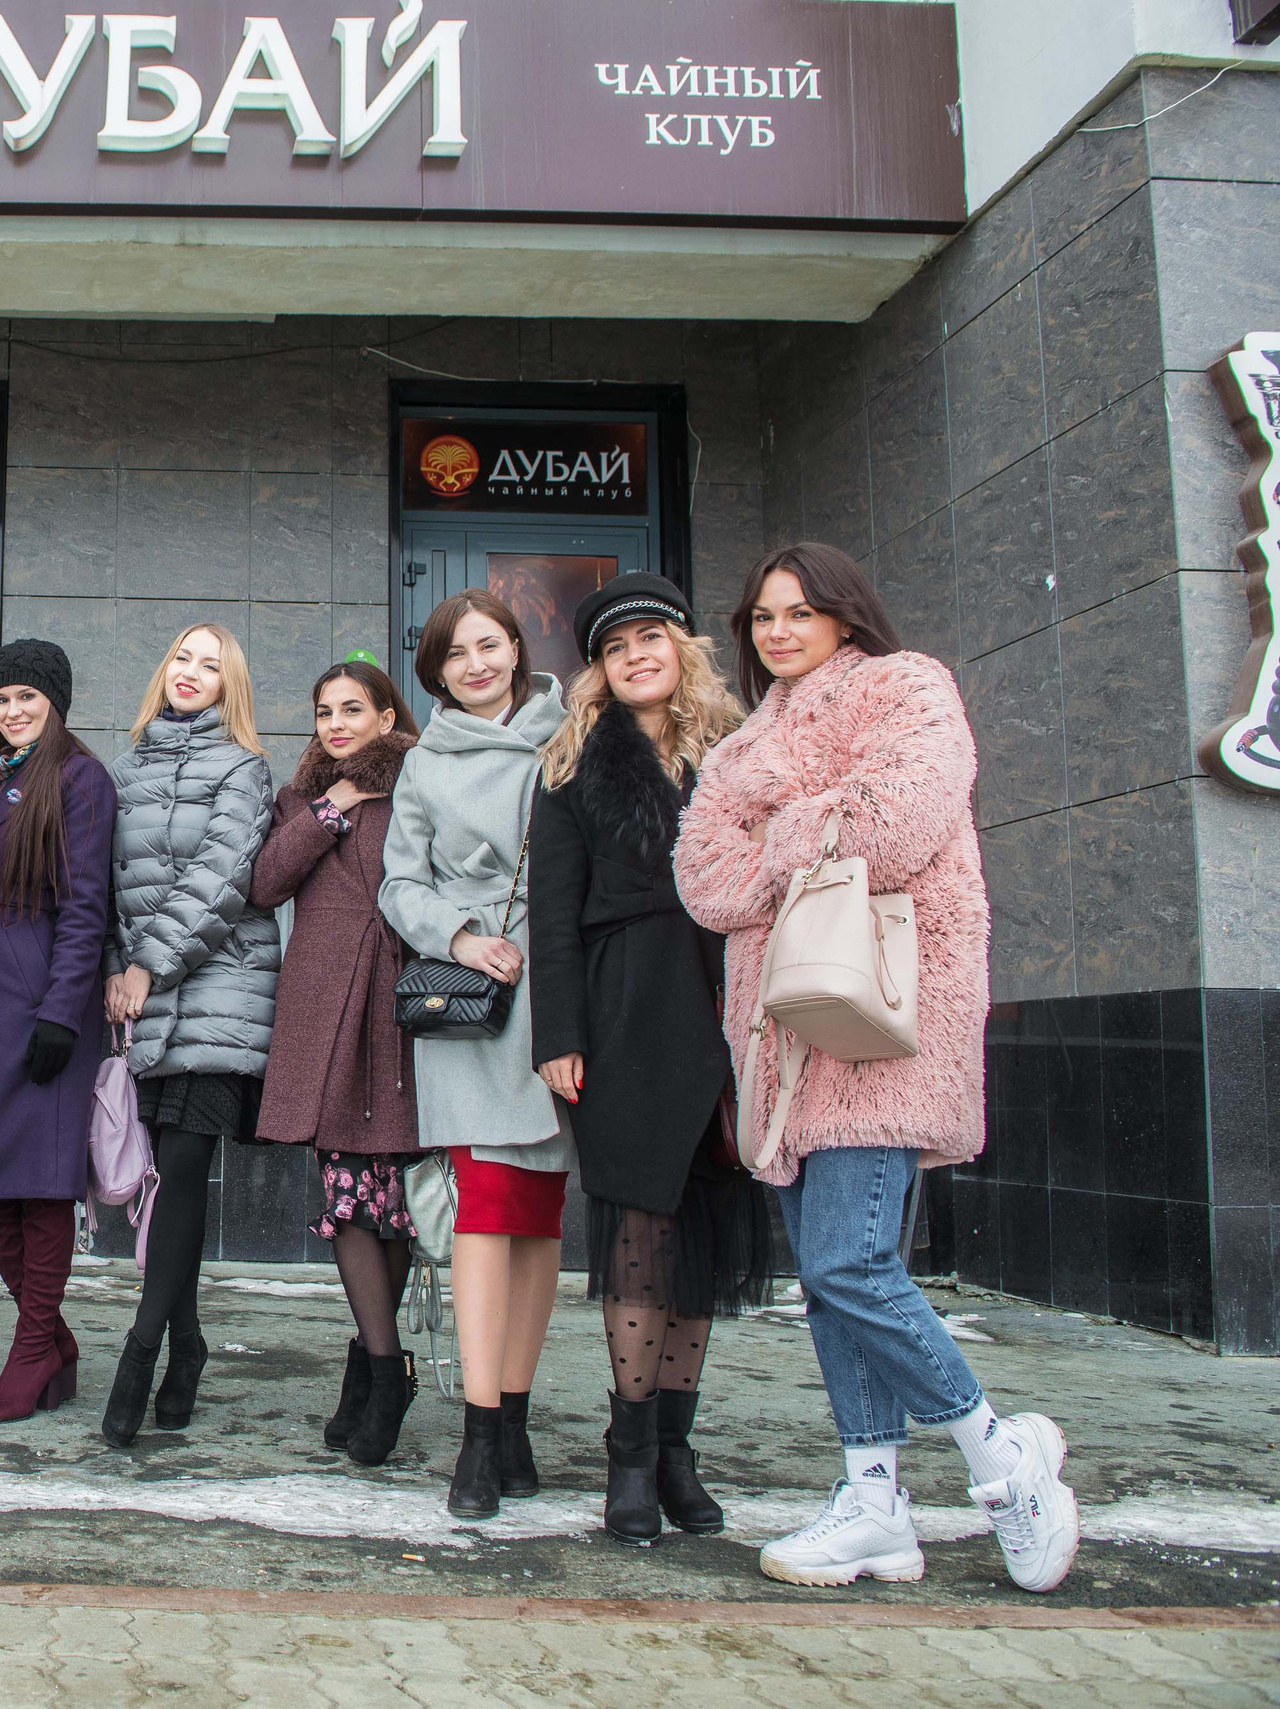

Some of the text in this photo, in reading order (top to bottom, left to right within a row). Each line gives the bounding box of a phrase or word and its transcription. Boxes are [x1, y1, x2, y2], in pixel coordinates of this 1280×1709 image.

[594, 56, 822, 100] ЧАЙНЫЙ
[644, 113, 776, 155] КЛУБ
[488, 443, 631, 484] ДУБАЙ
[488, 485, 632, 499] чайный клуб
